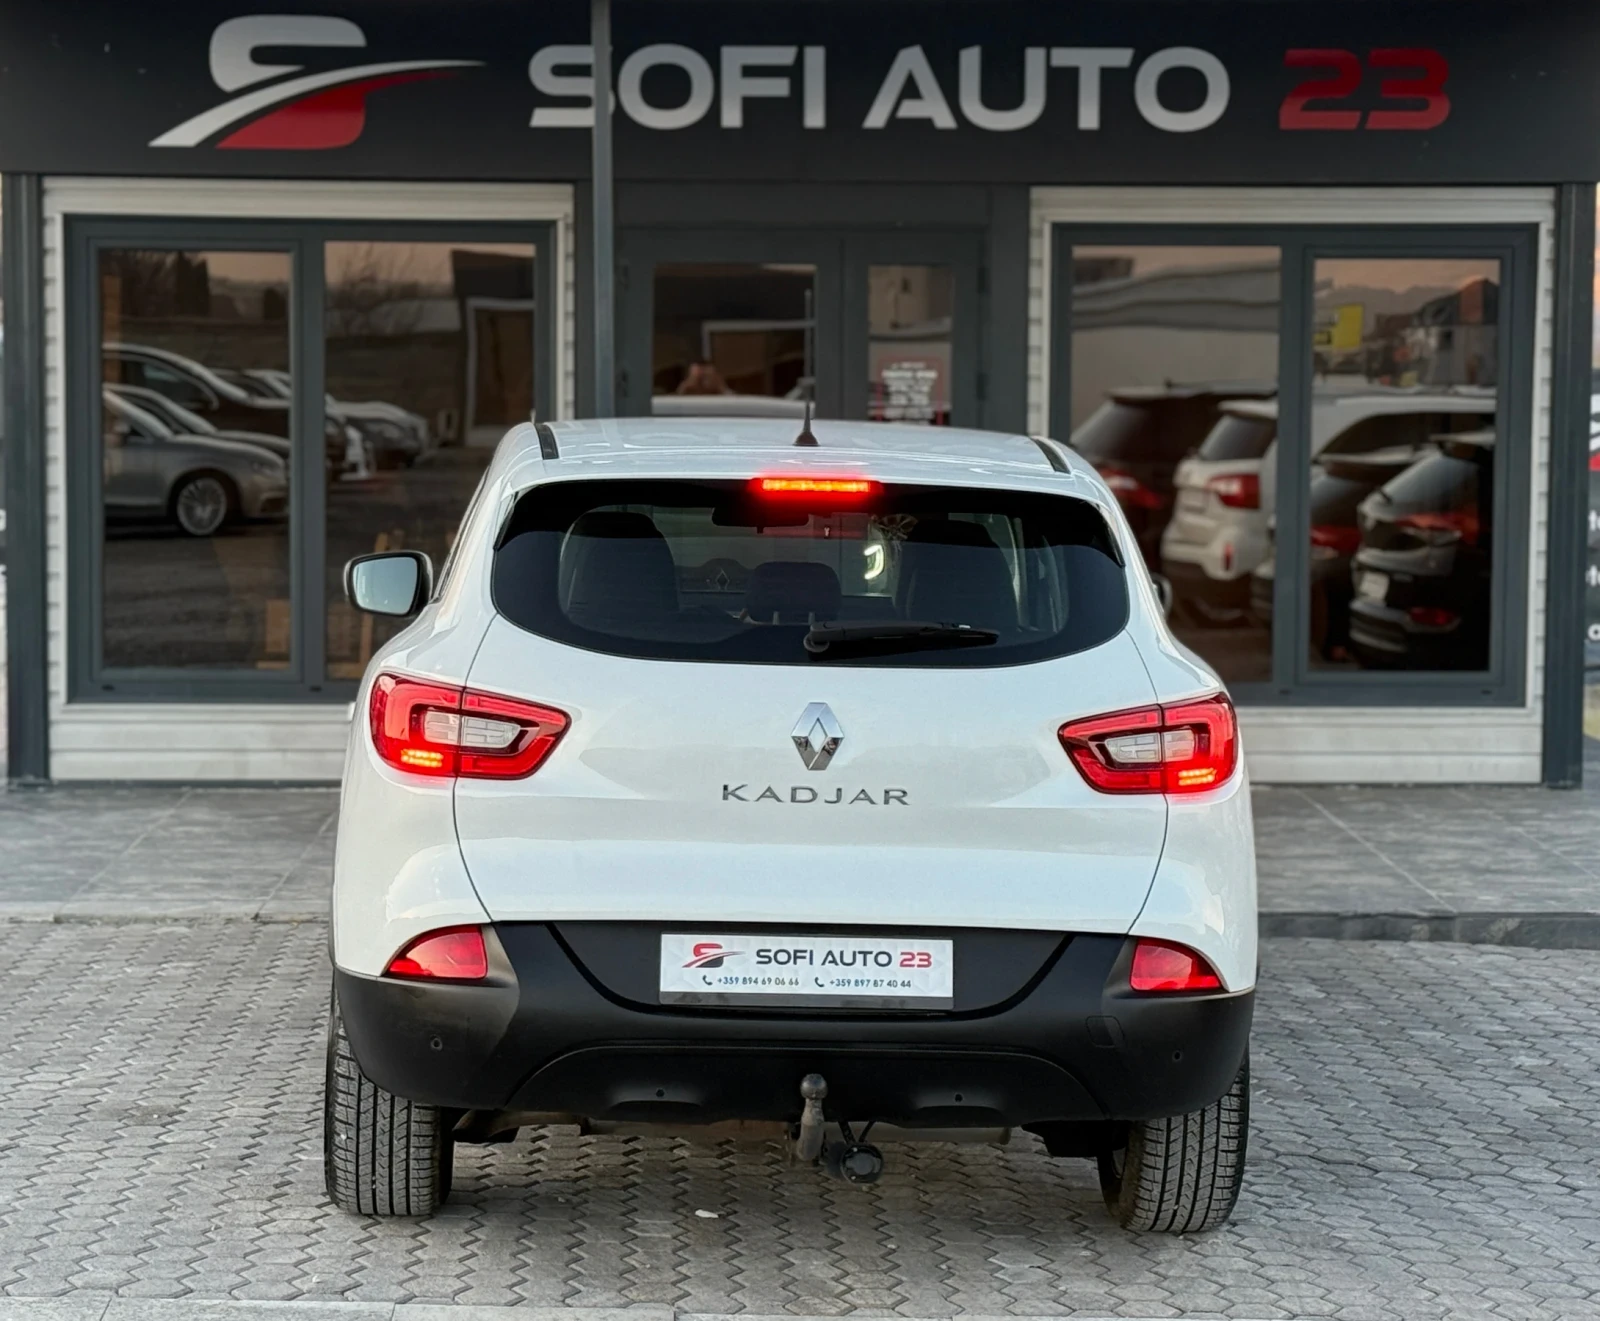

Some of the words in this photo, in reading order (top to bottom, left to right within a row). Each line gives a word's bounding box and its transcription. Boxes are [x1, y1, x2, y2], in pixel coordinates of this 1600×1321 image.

[528, 43, 827, 130] SOFI
[862, 45, 1231, 133] AUTO
[1279, 48, 1451, 131] 23
[722, 783, 911, 806] KADJAR
[756, 948, 814, 966] SOFI
[821, 949, 893, 968] AUTO
[899, 951, 932, 968] 23
[717, 976, 740, 986] +359
[741, 976, 759, 986] 894
[761, 976, 773, 986] 69
[774, 976, 786, 986] 06
[788, 977, 800, 986] 66
[829, 978, 852, 988] +359
[854, 978, 872, 988] 897
[873, 979, 885, 988] 87
[886, 979, 898, 988] 40
[900, 979, 912, 988] 44
